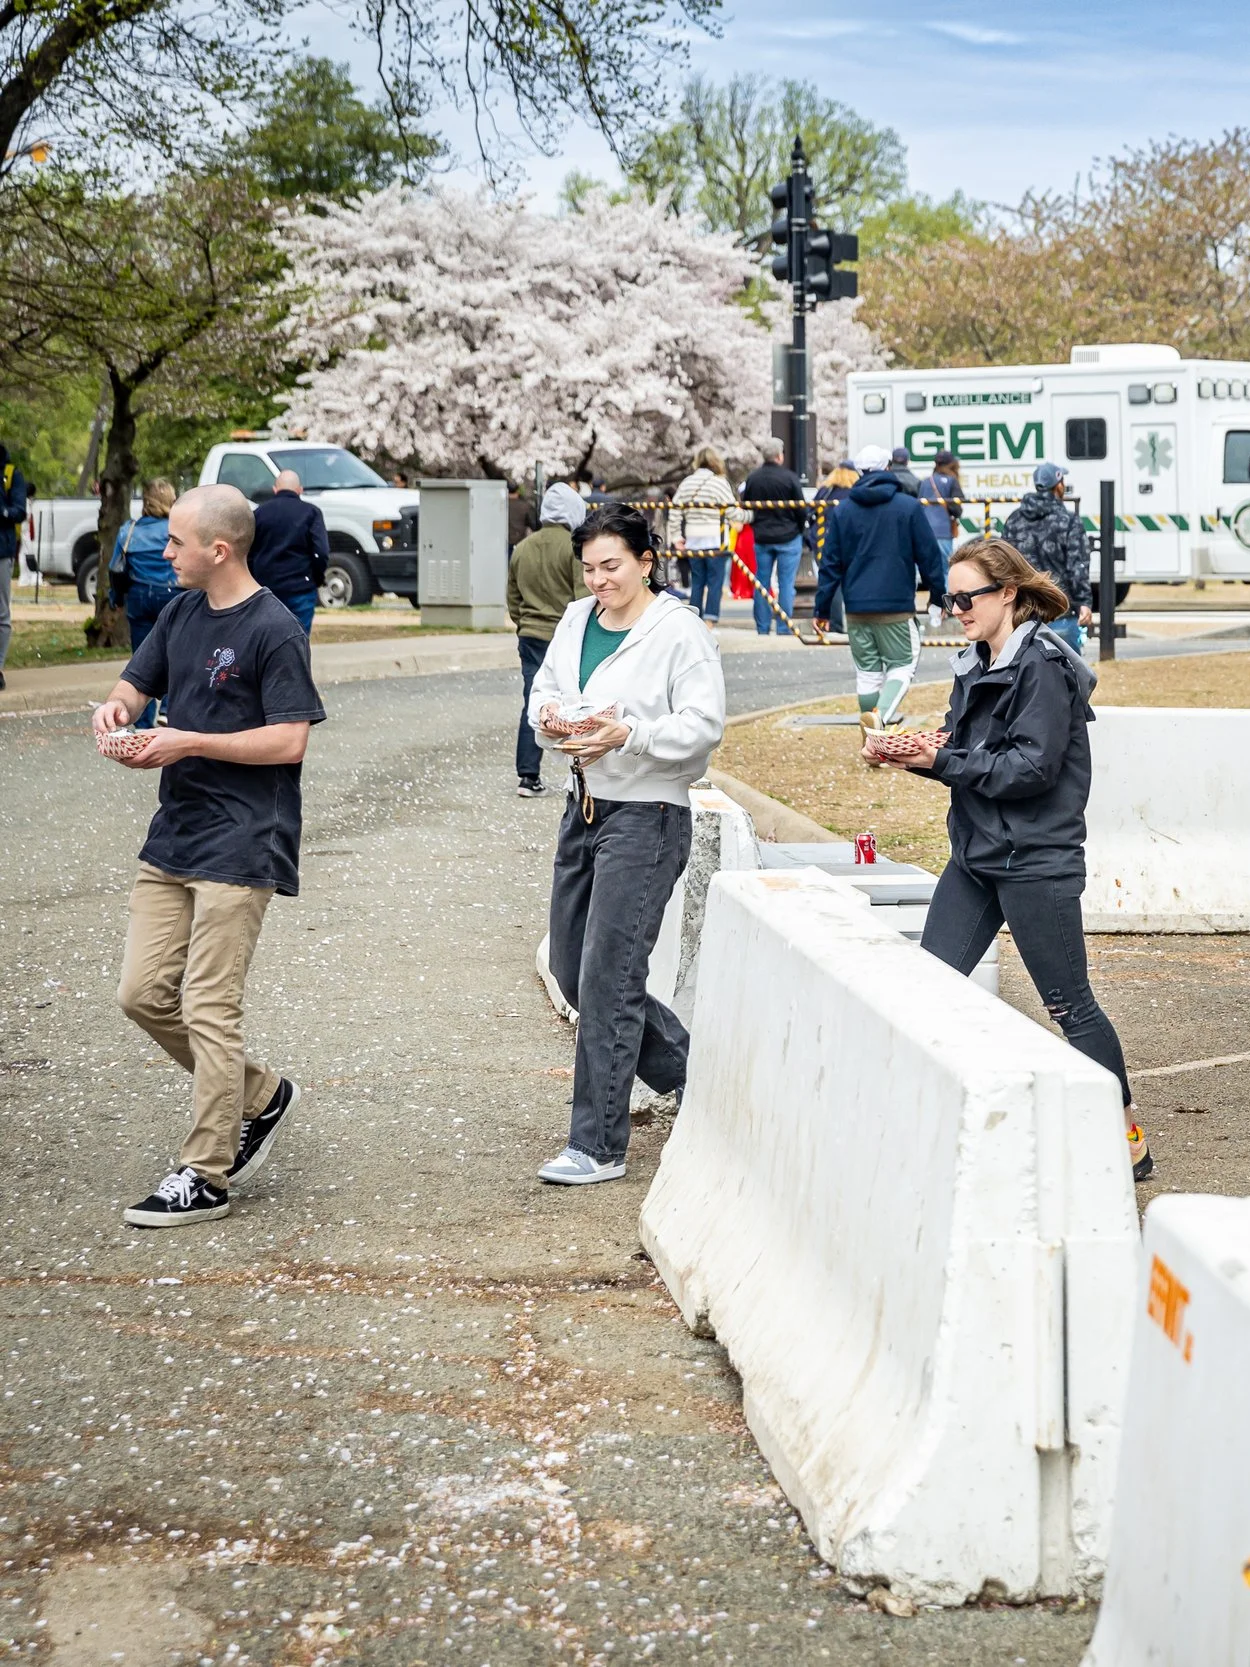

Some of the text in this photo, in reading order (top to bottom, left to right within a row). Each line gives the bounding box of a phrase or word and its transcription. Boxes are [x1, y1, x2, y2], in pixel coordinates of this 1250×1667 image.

[934, 393, 1031, 406] AMBULANCE
[904, 421, 1044, 462] GEM
[976, 473, 1033, 488] HEALT
